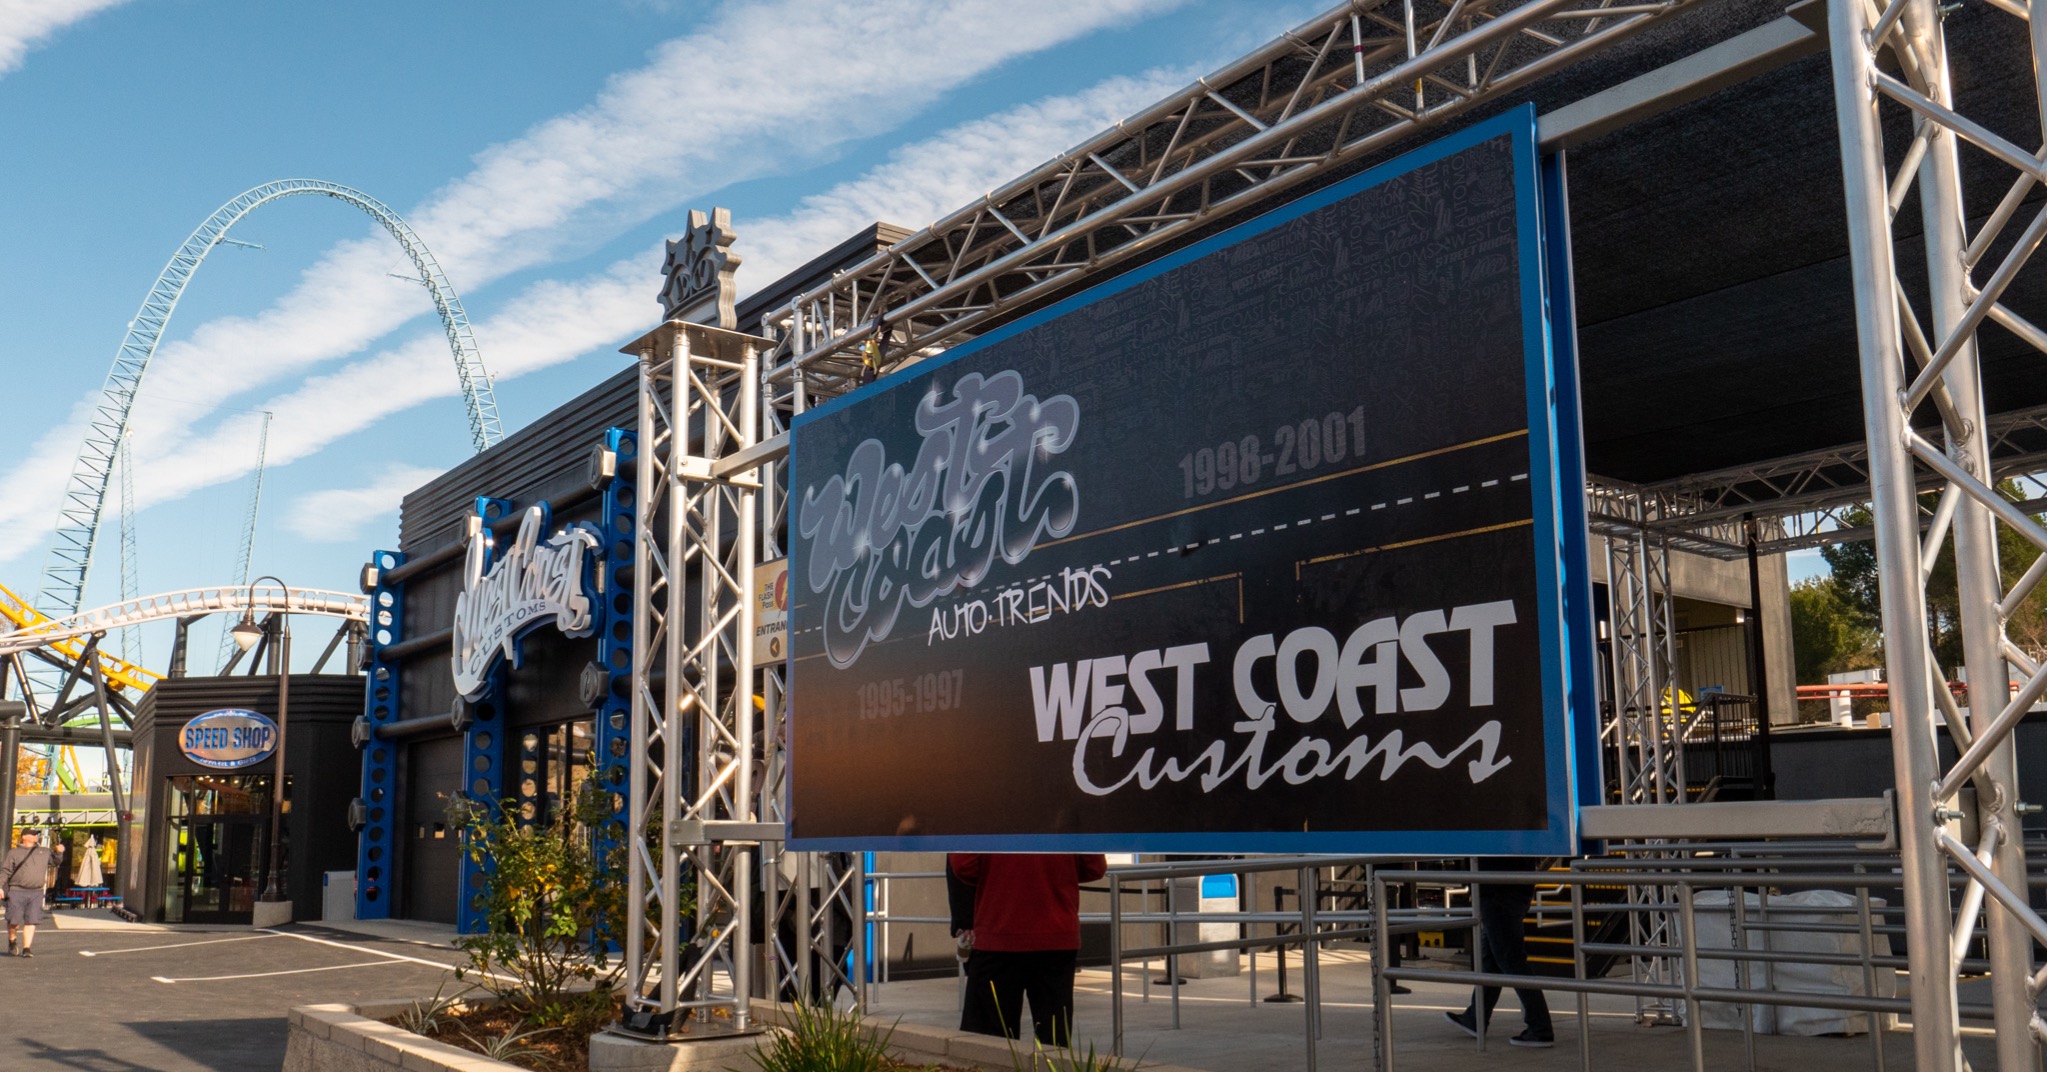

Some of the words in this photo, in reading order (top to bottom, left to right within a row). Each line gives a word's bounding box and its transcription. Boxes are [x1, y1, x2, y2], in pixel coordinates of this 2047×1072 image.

[1178, 405, 1367, 499] 1998-2001
[510, 506, 598, 632] Coast
[758, 591, 774, 601] FLASH
[470, 601, 547, 676] CUSTOMS
[756, 620, 788, 637] ENTRAN
[857, 668, 963, 720] 1995-1997
[1029, 642, 1211, 742] WEST
[1233, 599, 1518, 730] COAST
[185, 727, 228, 750] SPEED
[233, 726, 271, 749] SHOP
[1072, 705, 1513, 796] Customs
